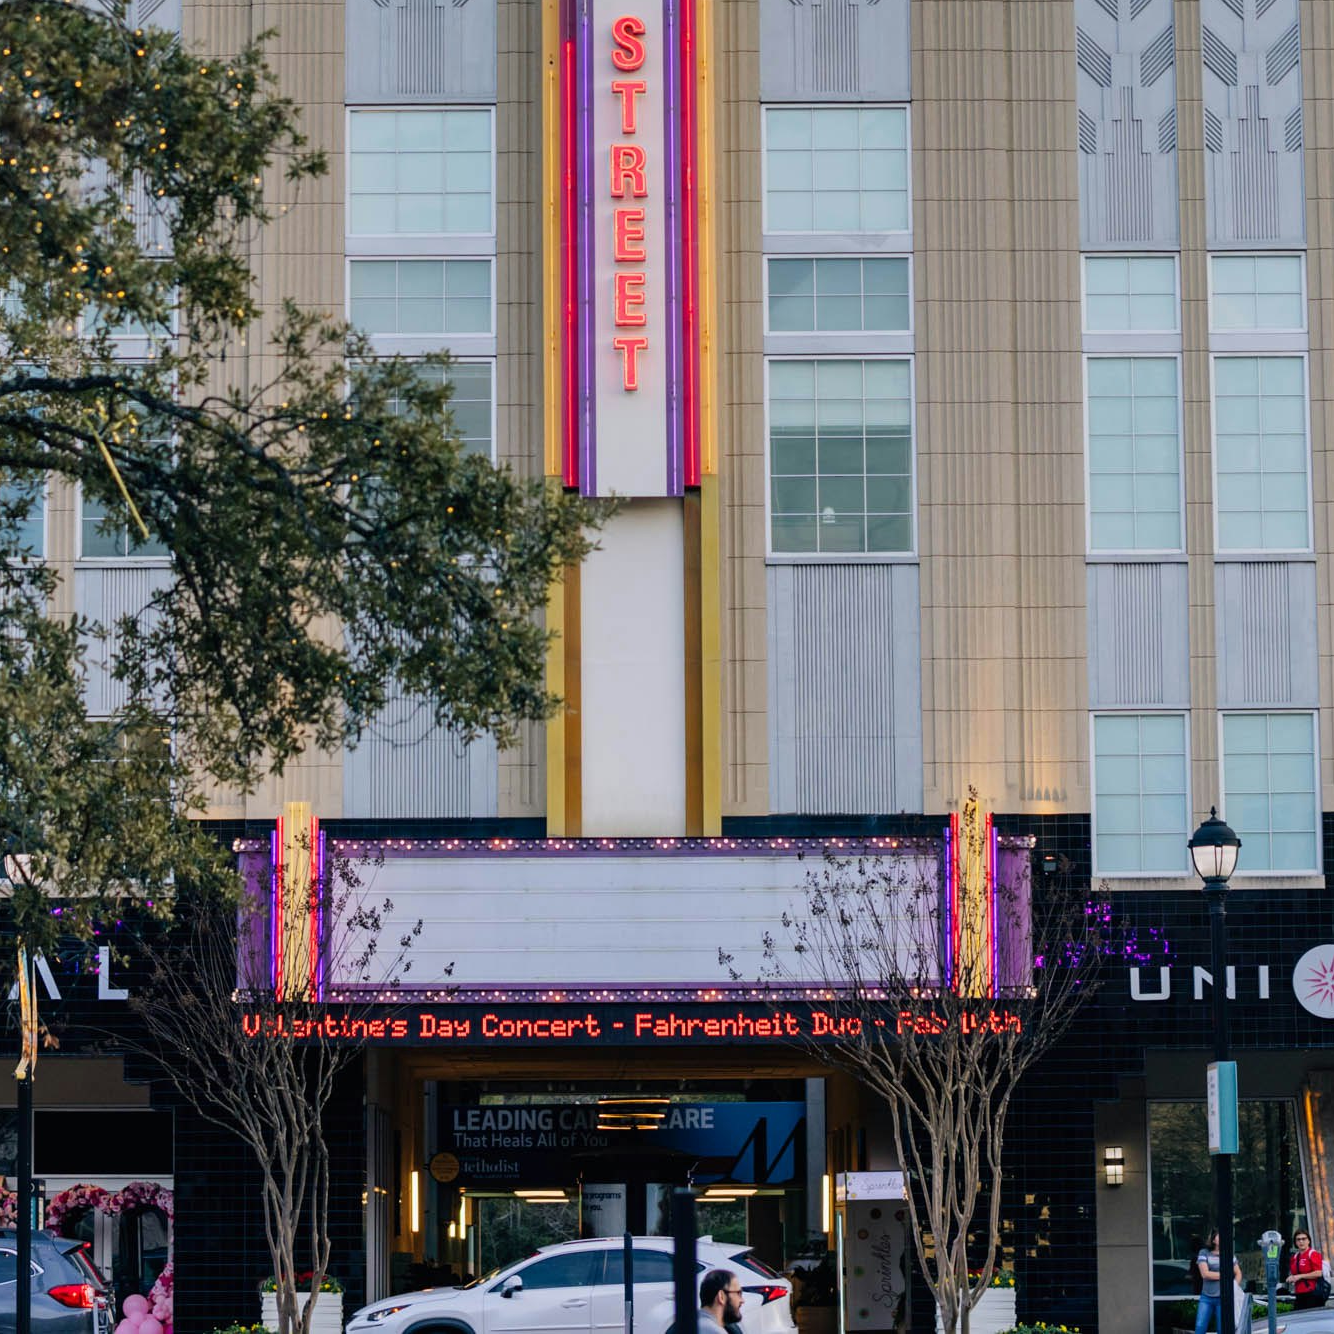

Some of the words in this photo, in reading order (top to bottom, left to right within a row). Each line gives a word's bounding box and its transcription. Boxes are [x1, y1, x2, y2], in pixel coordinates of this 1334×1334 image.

[609, 14, 648, 391] STREET
[1130, 965, 1269, 1000] UNI
[419, 1014, 470, 1037] Day
[482, 1014, 601, 1037] Concert
[635, 1012, 800, 1036] Fahrenheit
[812, 1012, 862, 1035] Duo
[454, 1109, 553, 1131] LEADING
[657, 1108, 715, 1130] CARE
[453, 1132, 488, 1148] That
[492, 1132, 533, 1148] Heals
[537, 1132, 557, 1148] All
[561, 1132, 576, 1147] of
[581, 1132, 608, 1147] You
[871, 1233, 901, 1308] Sprinkles
